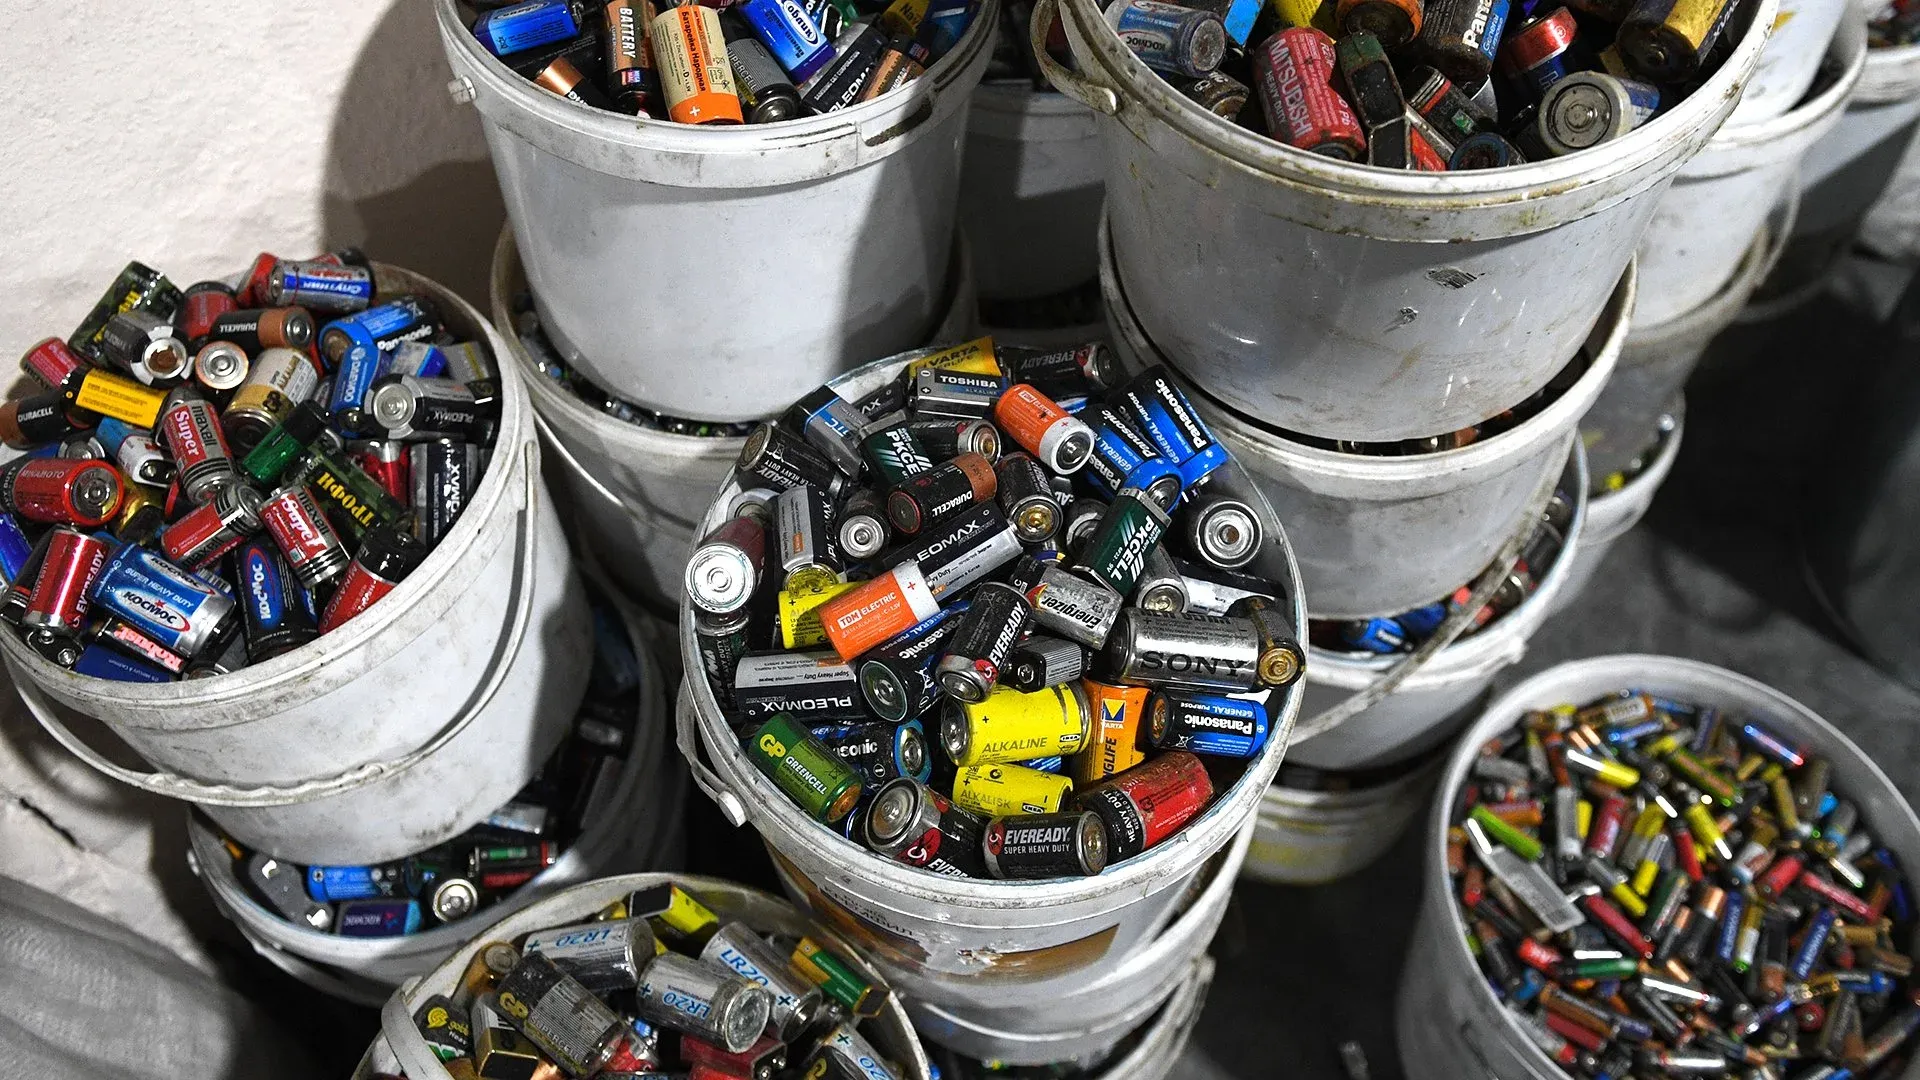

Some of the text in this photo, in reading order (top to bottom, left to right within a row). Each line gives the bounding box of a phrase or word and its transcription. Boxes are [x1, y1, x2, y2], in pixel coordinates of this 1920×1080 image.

[619, 6, 636, 59] BATTERY
[1126, 36, 1166, 51] КОСМОС
[681, 10, 707, 92] Батарейка Народная
[1265, 71, 1287, 124] HEAVY DUTY
[1269, 37, 1314, 138] MITSUBISHI
[219, 323, 258, 334] DURACELL
[1021, 350, 1075, 370] EVEREADY
[939, 374, 998, 389] TOSHIBA
[17, 406, 54, 422] DURACELL
[1127, 391, 1152, 422] PURPOSE
[1155, 377, 1207, 449] Panasonic
[174, 410, 200, 457] Super
[190, 405, 218, 447] maxell
[1100, 408, 1157, 459] Panasonic
[1150, 423, 1179, 464] GENERAL
[885, 430, 921, 474] PKCE
[764, 458, 800, 482] HEAVY DUTY
[1087, 456, 1121, 491] Panas
[299, 491, 328, 536] maxell
[316, 471, 377, 528] ТРОФИ
[932, 490, 973, 517] DURACELL
[282, 493, 327, 548] Super
[1107, 515, 1156, 584] PKCELL
[76, 549, 106, 613] EVEREADY
[1105, 562, 1115, 573] 9V
[124, 566, 195, 608] SUPER HEAVY DUTY
[252, 562, 273, 620] КОСМОС
[323, 566, 359, 628] MINAMOTO
[123, 590, 178, 625] КОСМОС
[839, 610, 862, 630] TDM
[860, 592, 898, 617] ELECTRIC
[1039, 596, 1102, 631] Energizer
[989, 602, 1027, 663] EVEREADY
[1138, 651, 1247, 678] SONY
[763, 695, 852, 714] PLEOMAX
[1180, 701, 1253, 718] GENERAL PURPOSE
[1061, 734, 1080, 742] IKEA
[1184, 714, 1252, 734] Panasonic
[759, 733, 787, 758] GP
[982, 737, 1048, 753] ALKALINE
[785, 755, 828, 795] GREENCELL
[960, 789, 1012, 809] ALKALISK
[1023, 804, 1043, 813] IKEA
[1101, 789, 1136, 843] HEAVY DUTY
[1004, 828, 1071, 845] EVEREADY
[1004, 843, 1070, 855] SUPER HEAVY DUTY
[556, 927, 610, 948] LR20
[662, 991, 712, 1020] LR20
[528, 1013, 582, 1063] SUPERCELL
